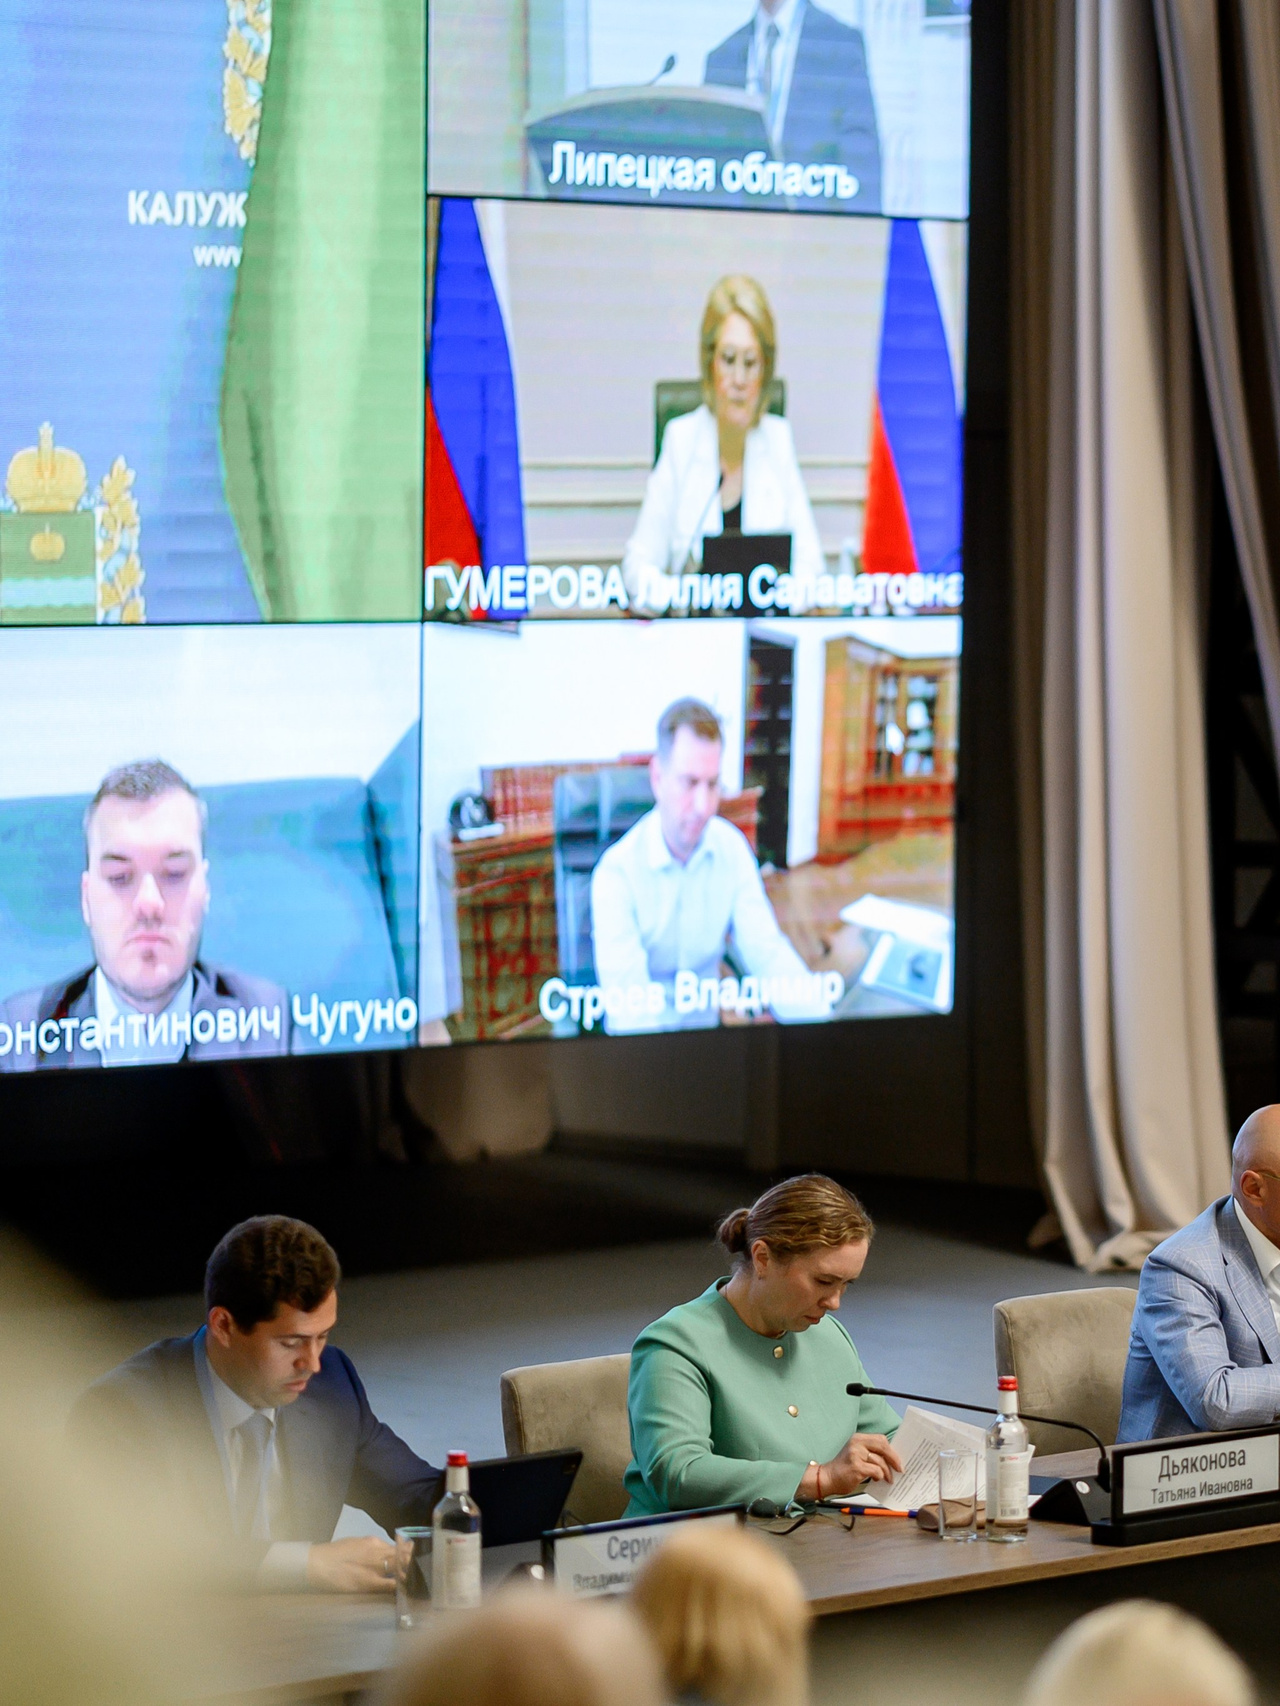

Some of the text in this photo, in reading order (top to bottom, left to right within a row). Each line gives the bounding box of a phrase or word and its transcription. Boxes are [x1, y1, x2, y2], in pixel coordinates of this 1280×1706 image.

[549, 140, 860, 199] Липецкая область
[128, 190, 248, 227] КАЛУЖ
[425, 564, 963, 610] ГУМЕРОВА Лилия Салаватовна
[292, 993, 418, 1045] Чугуно
[539, 970, 845, 1031] Строев Владимир
[1158, 1449, 1246, 1483] Дьяконова
[1151, 1478, 1253, 1505] Татьяна Ивановна
